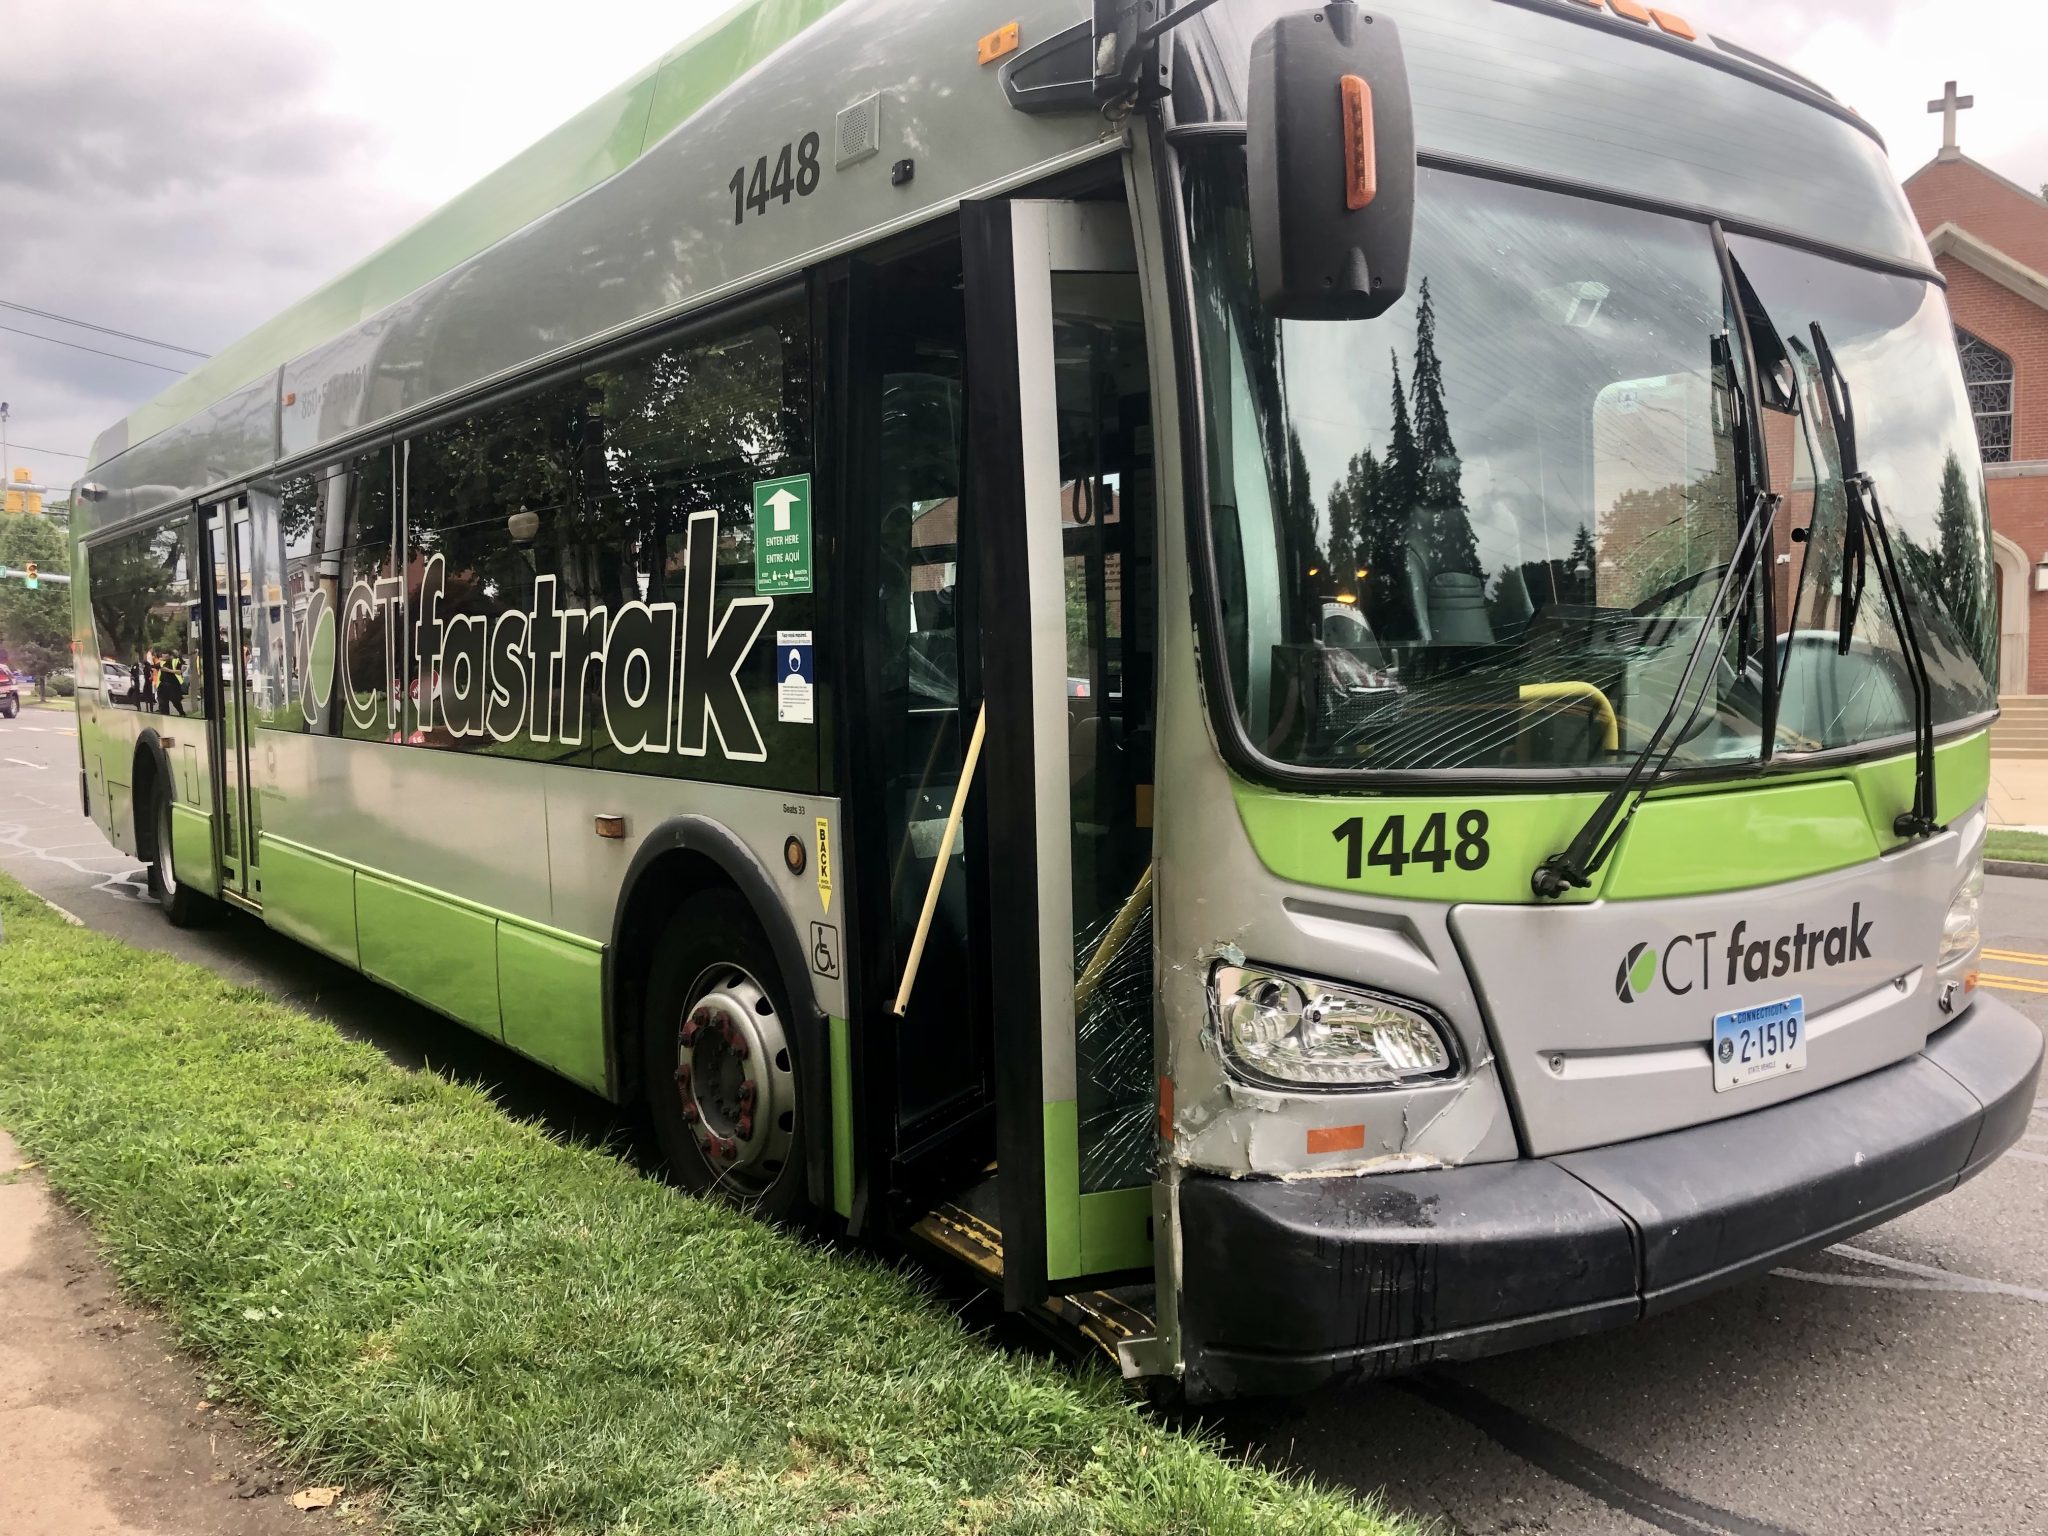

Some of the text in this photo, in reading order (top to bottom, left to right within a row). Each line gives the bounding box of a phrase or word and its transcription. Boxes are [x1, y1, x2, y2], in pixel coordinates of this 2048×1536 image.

[729, 131, 820, 225] 1448
[766, 533, 800, 547] ENTER HERE
[766, 550, 800, 564] ENTRE AQUÍ
[342, 510, 774, 762] CT fastrak
[783, 804, 806, 815] Seats 33
[819, 828, 828, 878] BACK
[1332, 808, 1491, 879] 1448
[1661, 901, 1873, 996] CT fastrak
[1737, 1003, 1783, 1024] CONNECTICUT
